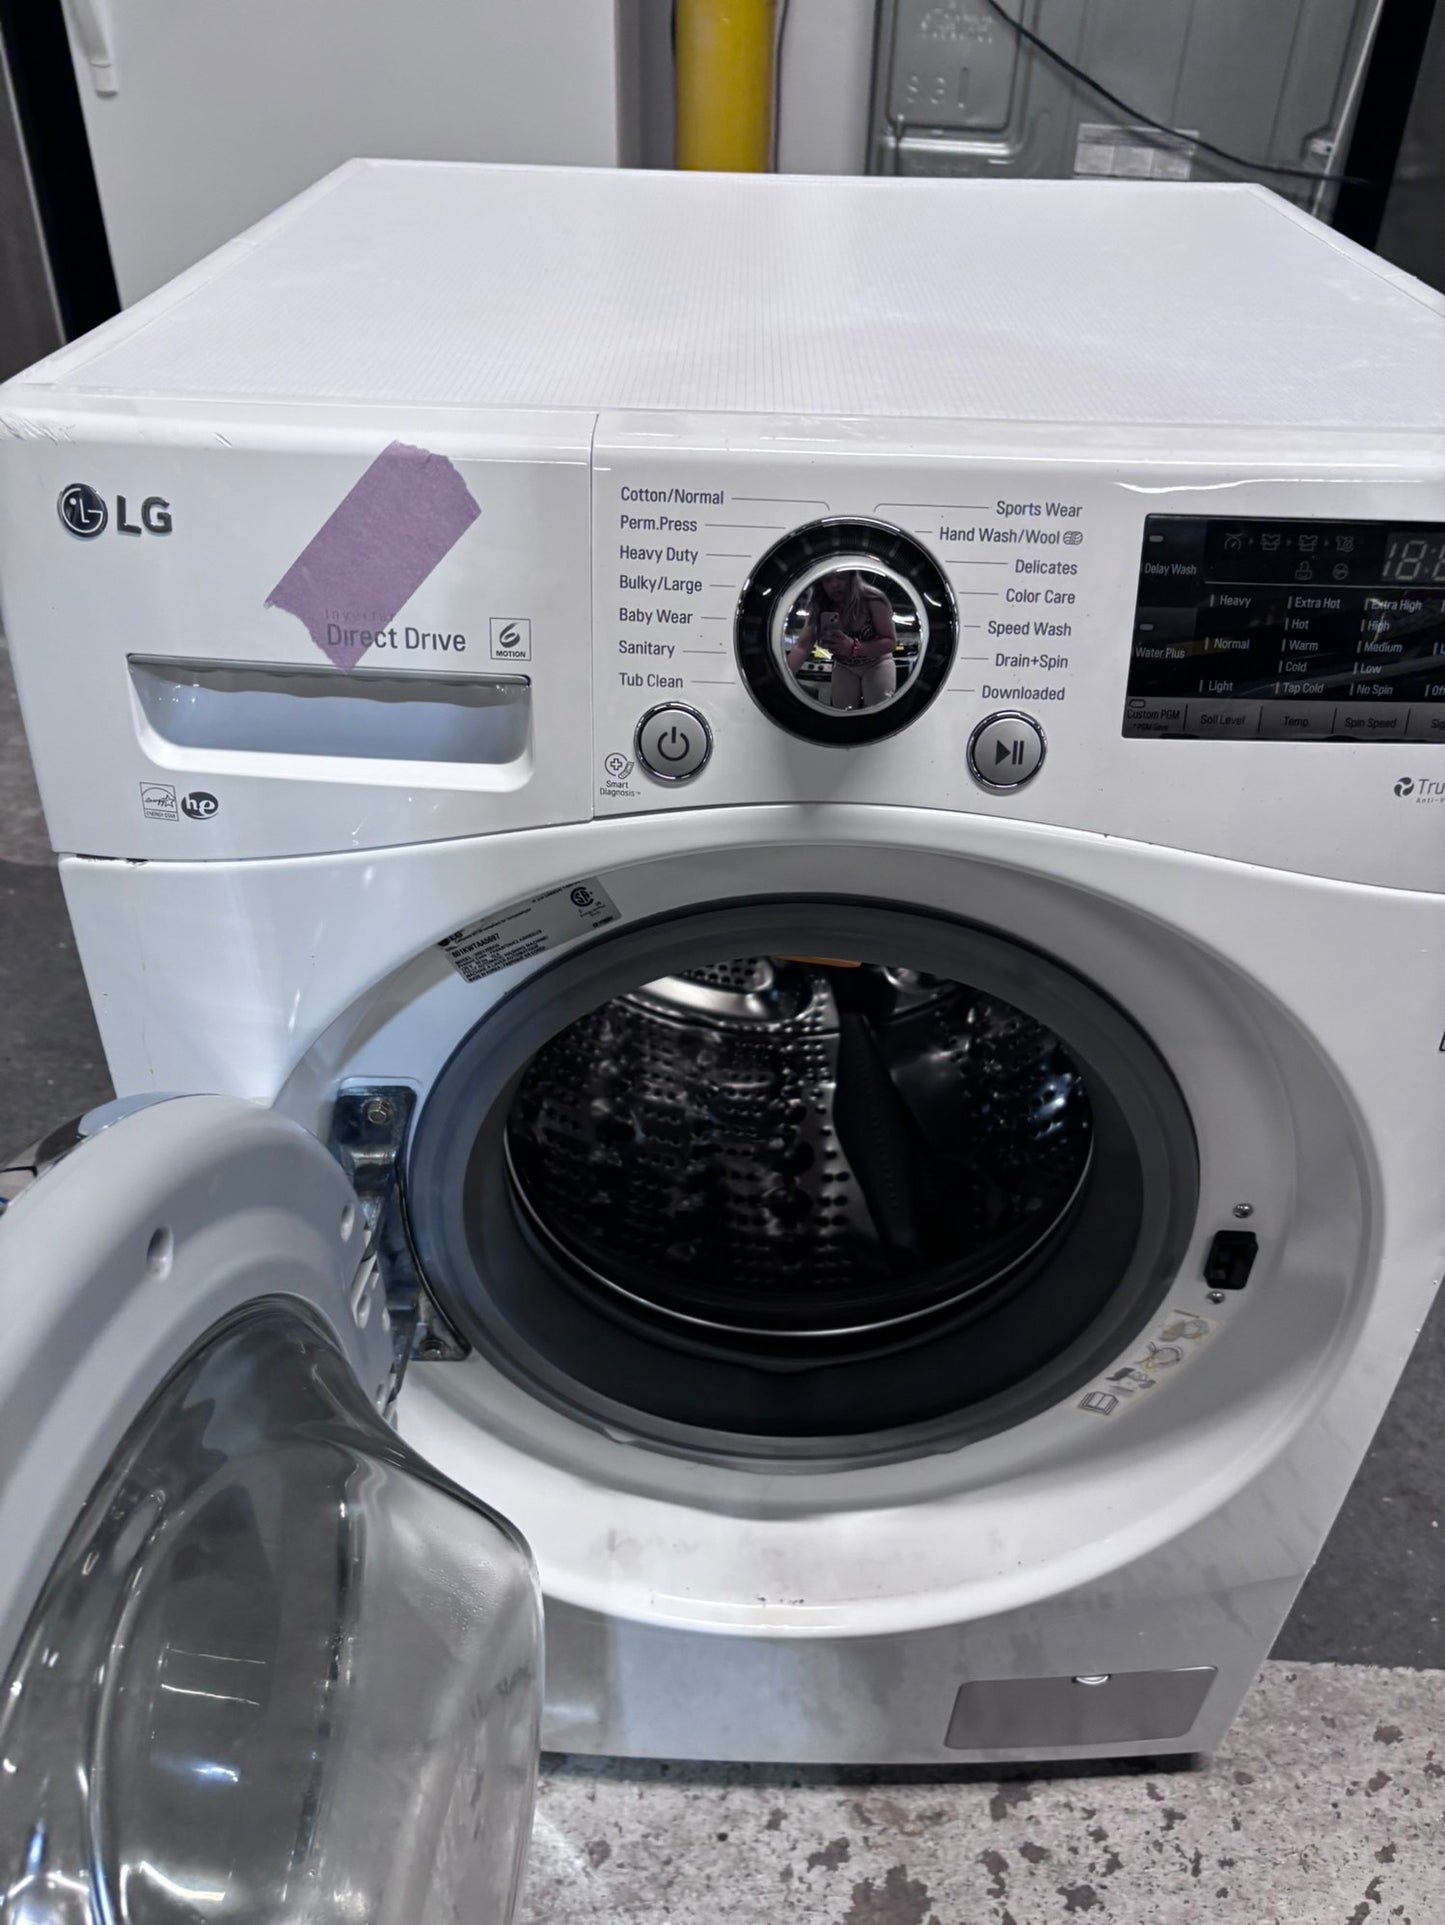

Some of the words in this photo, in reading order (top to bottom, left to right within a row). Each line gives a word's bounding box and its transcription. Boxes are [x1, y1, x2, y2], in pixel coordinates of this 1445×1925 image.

[621, 487, 724, 505] Cotton/Normal
[117, 495, 172, 534] LG
[996, 500, 1041, 519] Sports
[1045, 503, 1082, 518] Wear
[620, 515, 697, 532] Perm.Press
[939, 527, 975, 542] Hand
[980, 528, 1060, 545] Wash/Wool
[620, 545, 663, 564] Heavy
[666, 547, 698, 566] Duty
[1015, 559, 1077, 575] Delicates
[1145, 563, 1170, 576] Delay
[1171, 564, 1197, 576] Wash
[619, 575, 702, 594] Bulky/Large
[1006, 588, 1042, 604] Color
[1045, 590, 1075, 604] Care
[1220, 595, 1251, 608] Heavy
[1295, 597, 1320, 609] Extra
[1323, 598, 1340, 609] Hot
[1399, 600, 1422, 612] High
[619, 608, 653, 625] Baby
[656, 609, 693, 624] Wear
[988, 621, 1031, 639] Speed
[1034, 622, 1071, 637] Wash
[1292, 619, 1309, 630] Hot
[1368, 620, 1390, 632] High
[327, 623, 398, 649] Direct
[405, 627, 466, 651] Drive
[619, 641, 675, 658] Sanitary
[1215, 638, 1250, 650] Normal
[1289, 640, 1318, 651] Warm
[1364, 642, 1402, 653] Medium
[496, 650, 527, 658] MOTION
[1136, 647, 1164, 659] Water
[1166, 647, 1185, 659] Plus
[995, 653, 1068, 670] Drain+Spin
[1285, 661, 1307, 672] Cold
[1360, 663, 1382, 674] Low
[620, 672, 643, 686] Tub
[646, 673, 683, 688] Clean
[1209, 680, 1233, 693] Light
[982, 685, 1065, 701] Downloaded
[1283, 682, 1301, 694] Tap
[1303, 683, 1324, 694] Cold
[1357, 684, 1370, 695] No
[1372, 684, 1393, 696] Spin
[1127, 709, 1159, 721] Custom
[1161, 709, 1180, 721] PGM
[1201, 714, 1217, 726] Soil
[1219, 716, 1245, 726] Level
[1345, 718, 1365, 729] Spin
[1367, 718, 1396, 729] Speed
[606, 779, 629, 789] Smart
